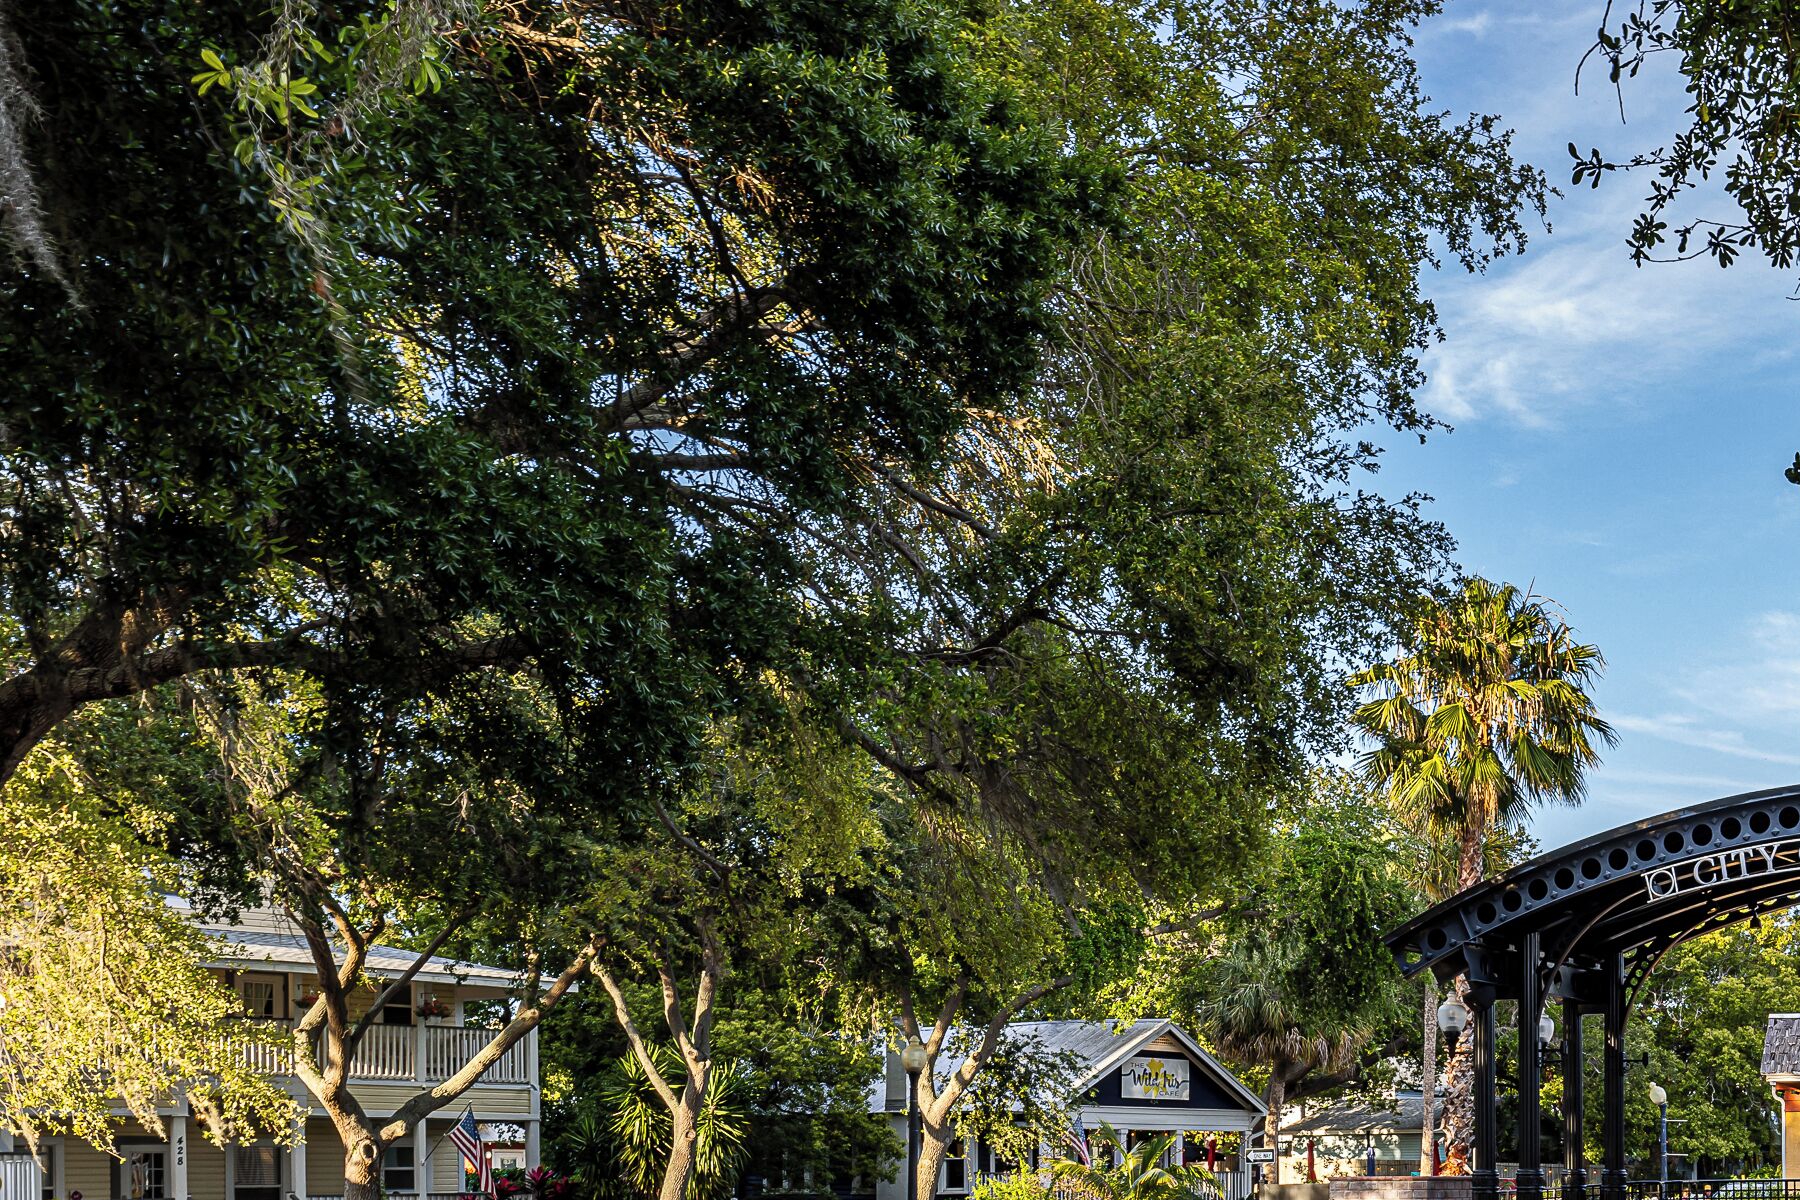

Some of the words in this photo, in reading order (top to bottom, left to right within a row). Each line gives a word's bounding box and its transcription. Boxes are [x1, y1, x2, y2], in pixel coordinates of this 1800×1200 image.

[1693, 843, 1781, 885] CITY
[1131, 1068, 1160, 1087] Wild
[1163, 1070, 1181, 1089] Iris
